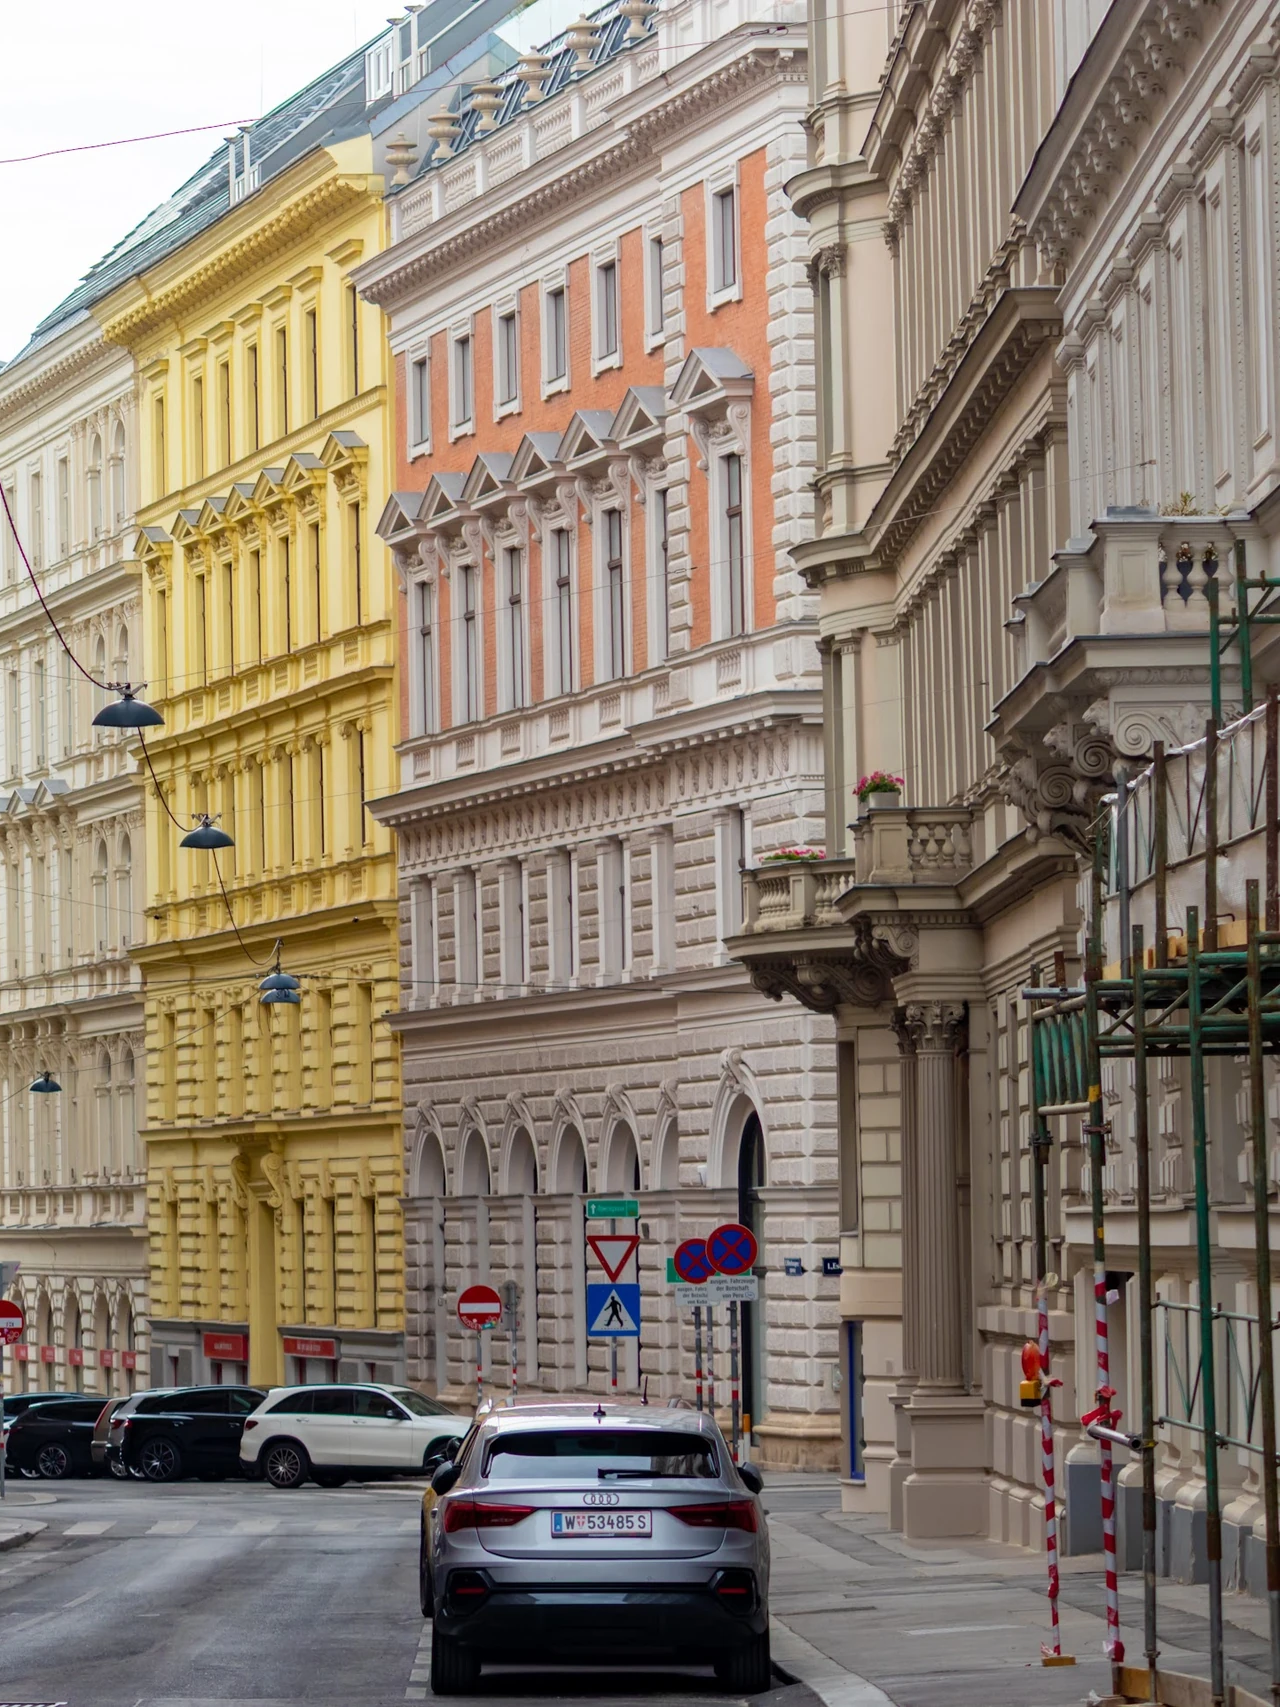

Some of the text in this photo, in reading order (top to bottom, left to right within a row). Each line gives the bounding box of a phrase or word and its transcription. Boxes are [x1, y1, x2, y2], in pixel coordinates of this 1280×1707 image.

[565, 1515, 646, 1530] W 53485 S
